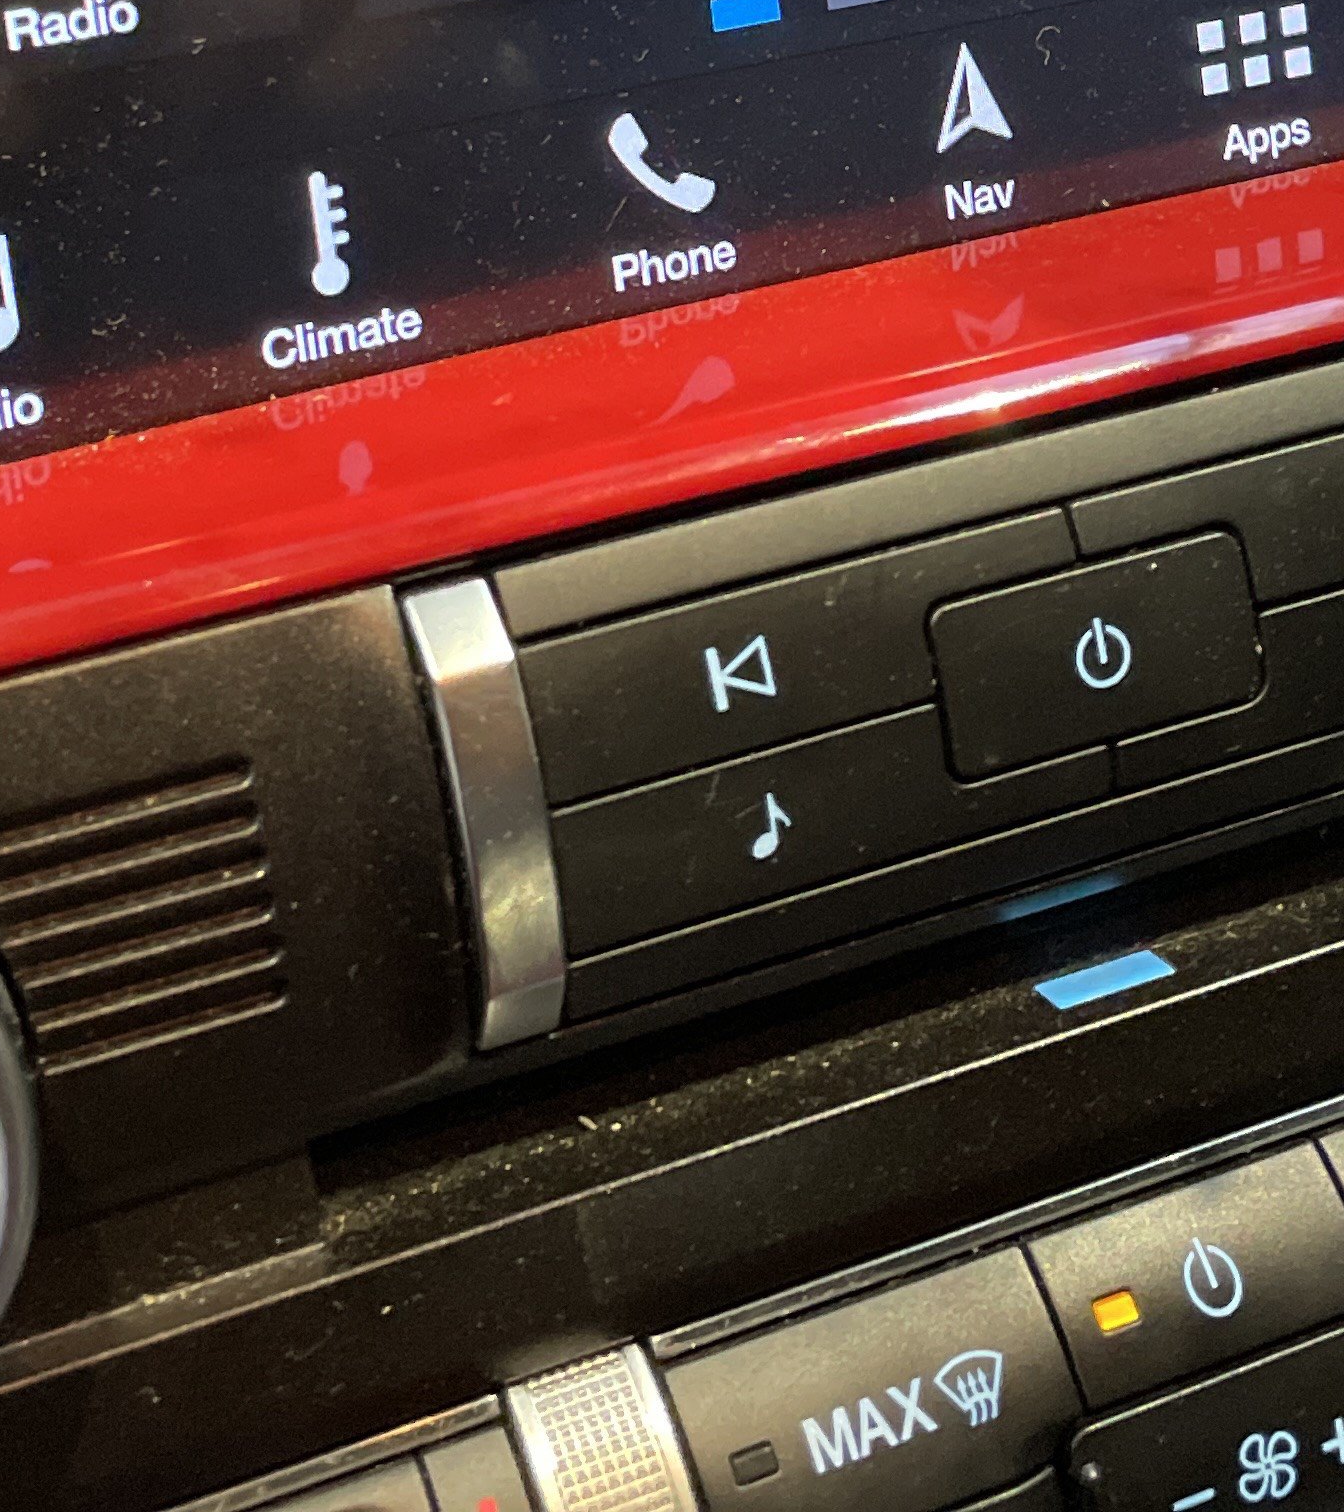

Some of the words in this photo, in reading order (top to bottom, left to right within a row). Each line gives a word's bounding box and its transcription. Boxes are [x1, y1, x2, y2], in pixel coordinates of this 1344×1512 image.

[1224, 118, 1311, 164] Apps
[945, 180, 1014, 220] Nav
[612, 241, 736, 292] Phone
[262, 308, 422, 368] Climate
[801, 1378, 937, 1473] MAX
